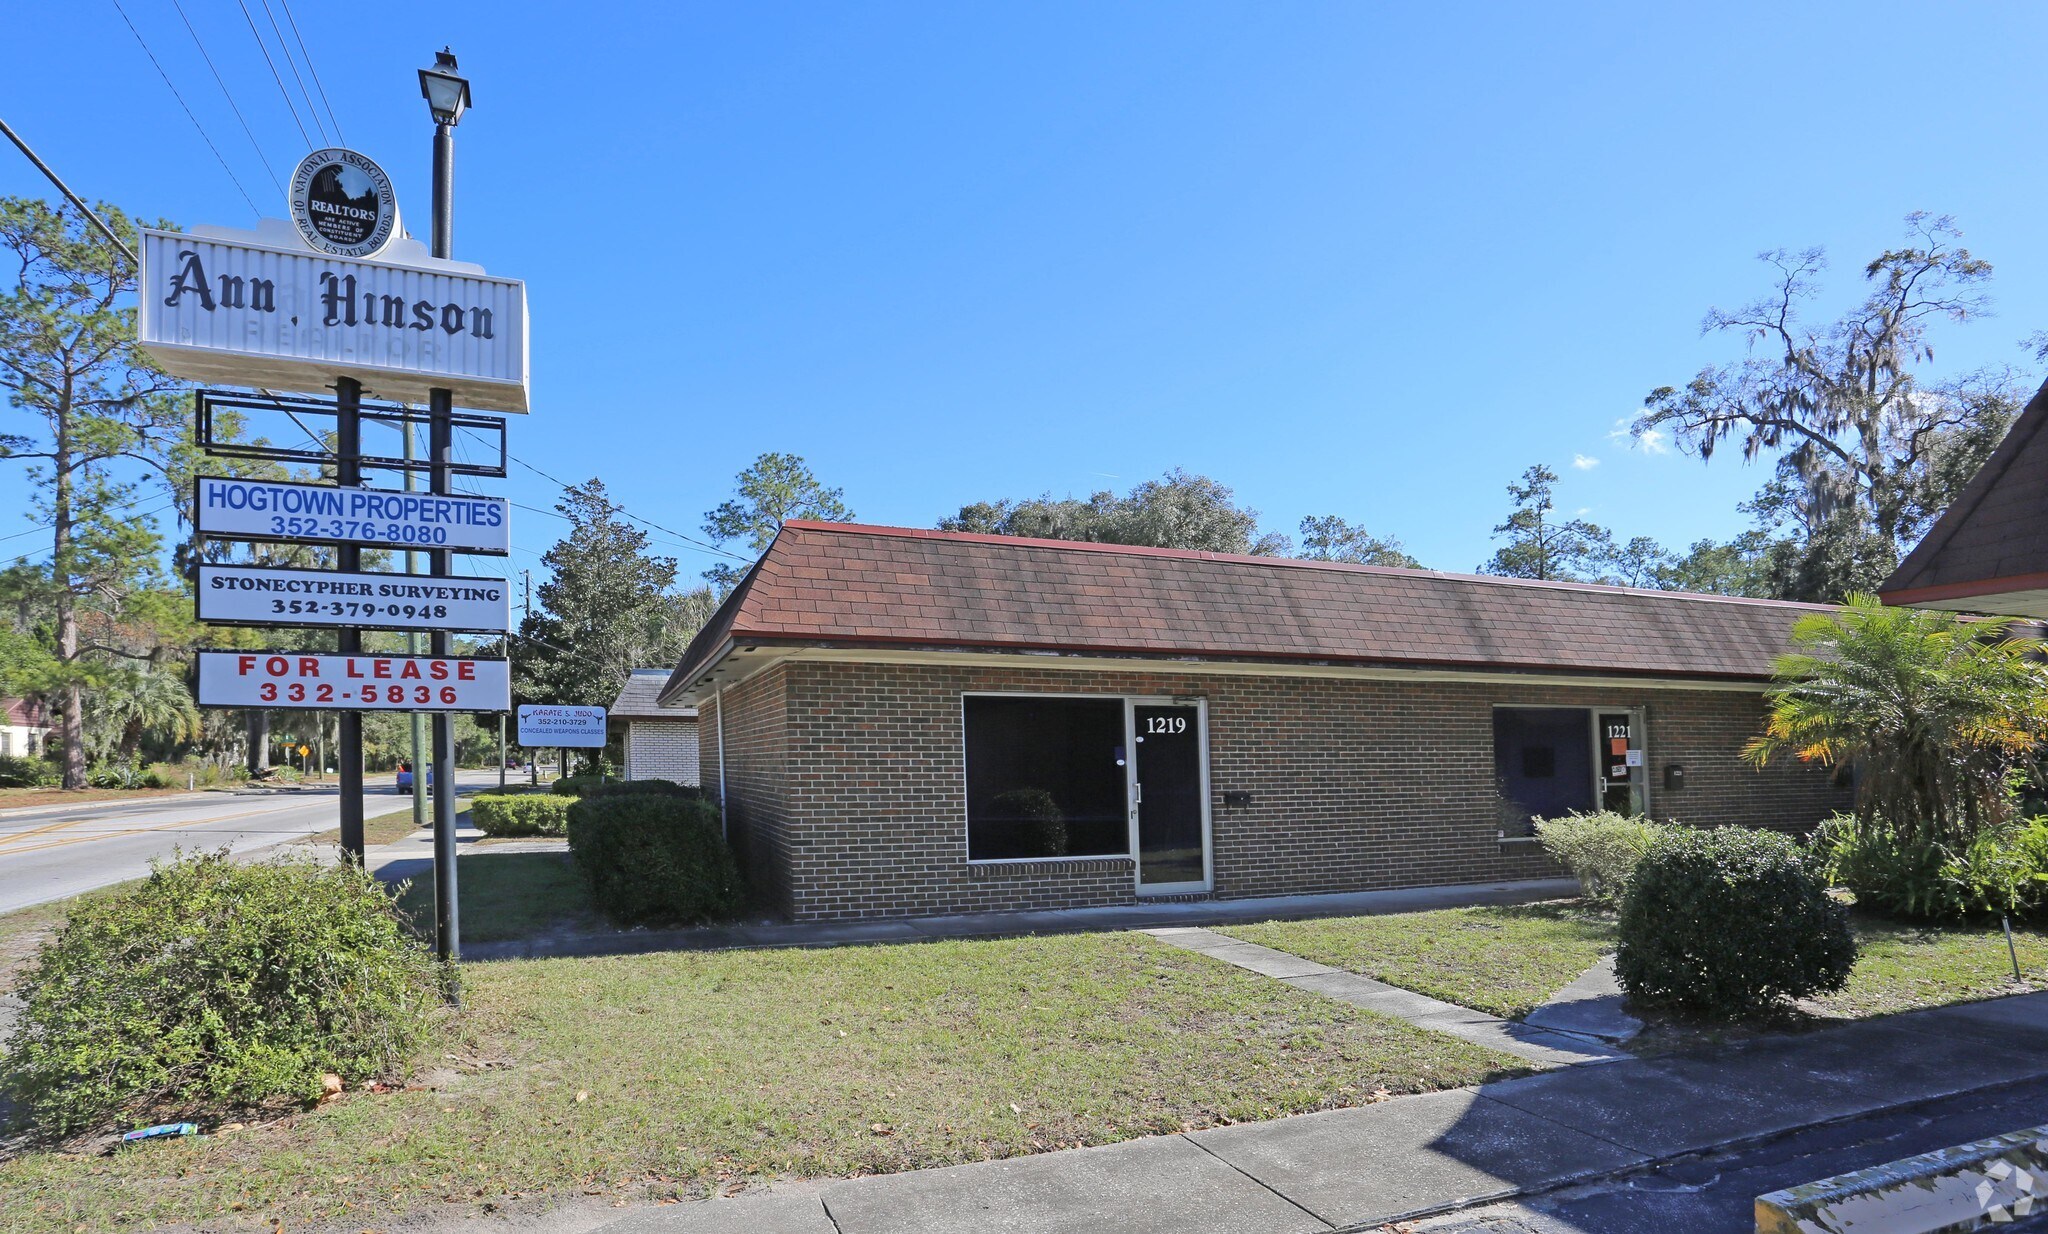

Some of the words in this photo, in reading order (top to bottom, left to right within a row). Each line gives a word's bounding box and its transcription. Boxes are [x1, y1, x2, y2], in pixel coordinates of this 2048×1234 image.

[295, 152, 334, 194] NATIONAL
[340, 152, 392, 206] ASSOCIATION
[293, 200, 305, 214] OF
[311, 200, 376, 221] REALTORS
[297, 218, 318, 244] REAL
[318, 221, 351, 231] MEMBERS
[319, 227, 362, 238] CONSTITUENT
[339, 219, 360, 227] ACTIVE
[367, 214, 392, 250] BOARDS
[323, 243, 365, 256] ESTATE
[164, 250, 276, 313] Ann
[320, 271, 494, 340] Hinson
[208, 483, 344, 517] HOGTOWN
[351, 493, 502, 527] PROPERTIES
[271, 516, 447, 544] 352-376-8080
[211, 576, 374, 597] STONECYPHER
[379, 584, 501, 602] SURVEYING
[271, 599, 448, 619] 352-379-0948
[238, 655, 320, 677] FOR
[347, 658, 476, 681] LEASE
[260, 682, 457, 704] 332-5836
[532, 709, 562, 717] KARATE
[538, 718, 587, 726] 352-210-3729
[1146, 717, 1186, 733] 1219
[1607, 725, 1632, 738] 1221
